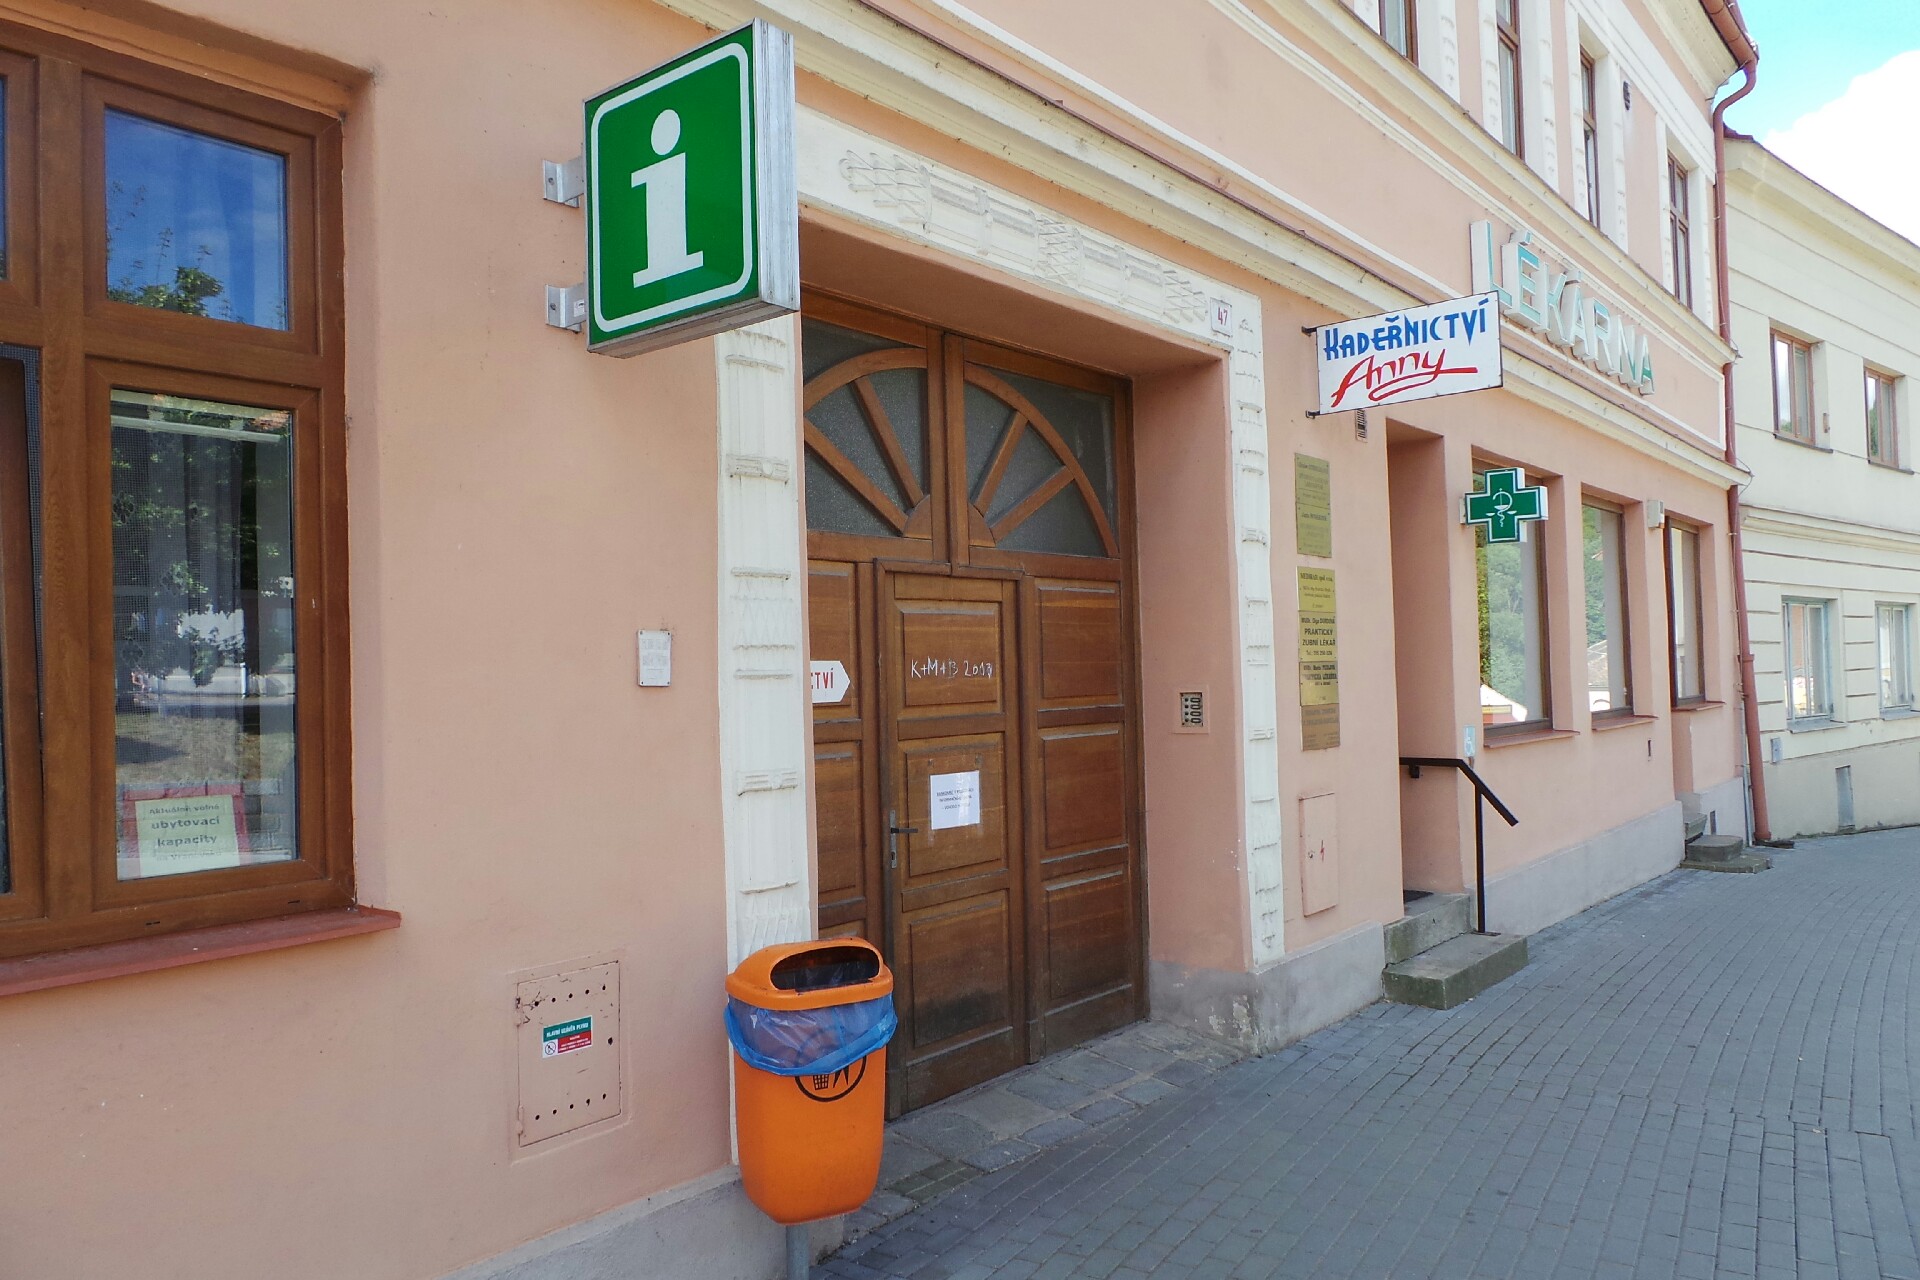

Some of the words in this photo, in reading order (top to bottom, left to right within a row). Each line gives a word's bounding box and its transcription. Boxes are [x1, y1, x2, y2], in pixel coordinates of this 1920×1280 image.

[1217, 306, 1228, 326] 47
[1323, 297, 1489, 361] KADEŘNICTVÍ
[1470, 219, 1655, 395] LÉKÁRNA
[1331, 348, 1478, 408] Anny
[157, 834, 217, 848] kapacity
